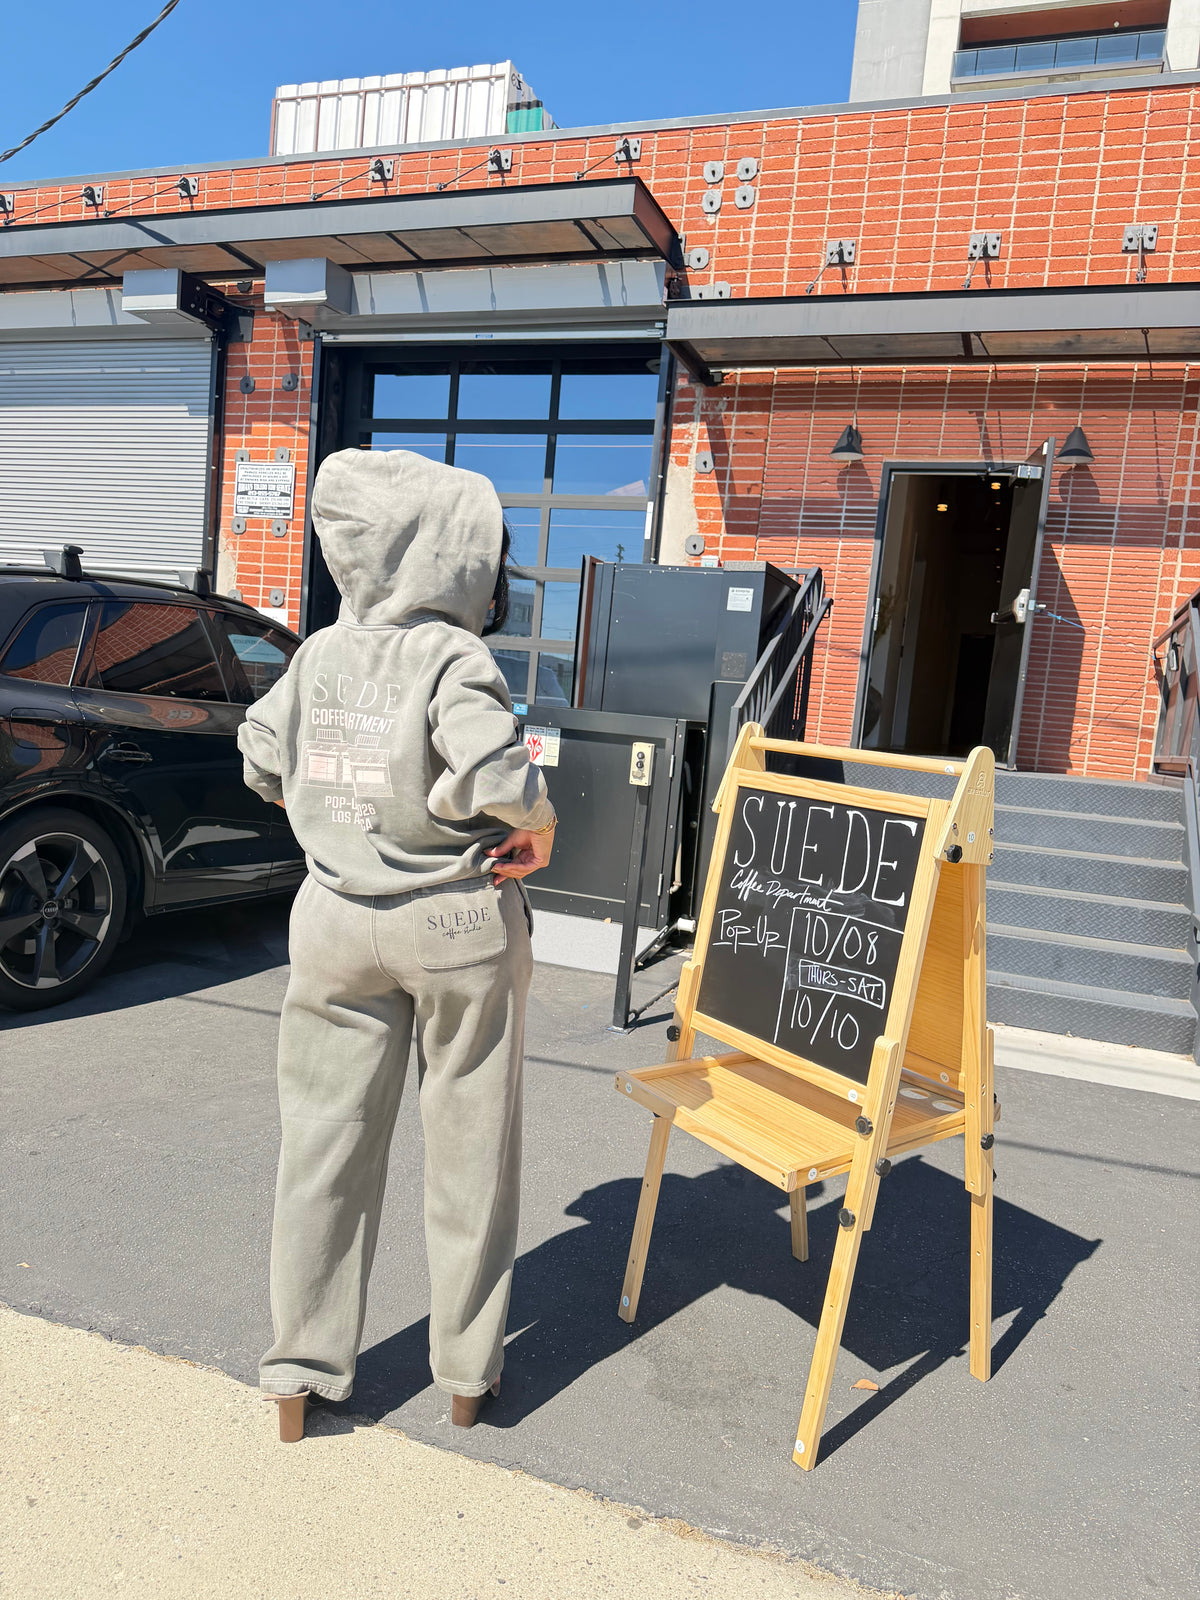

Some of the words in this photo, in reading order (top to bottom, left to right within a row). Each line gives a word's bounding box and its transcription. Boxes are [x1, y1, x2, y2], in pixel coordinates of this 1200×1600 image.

[332, 810, 351, 824] LOS
[733, 796, 918, 907] SUEDE
[730, 868, 765, 902] Coffee
[427, 906, 491, 931] SUEDE
[803, 912, 879, 965] 10/08
[790, 990, 860, 1050] 10/10
